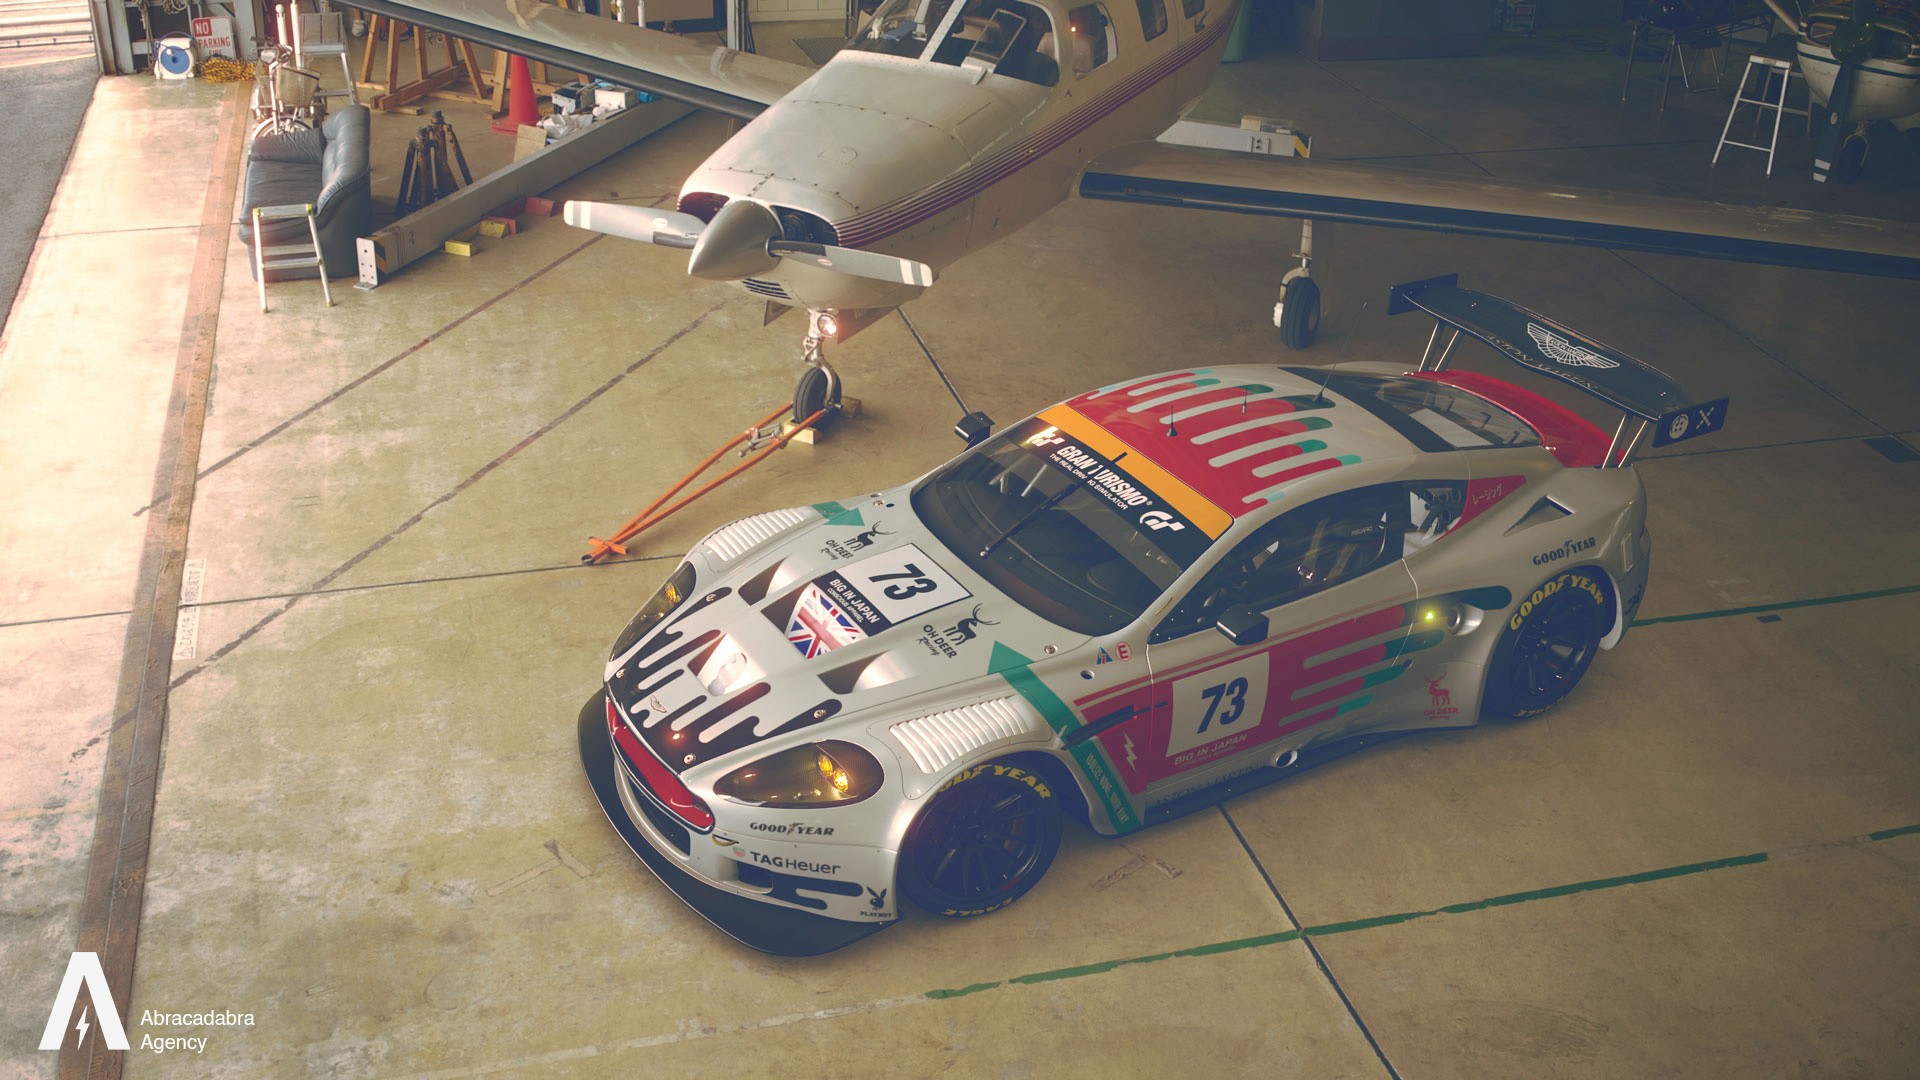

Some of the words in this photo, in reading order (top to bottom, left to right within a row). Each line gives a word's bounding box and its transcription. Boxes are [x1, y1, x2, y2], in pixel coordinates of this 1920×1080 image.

[195, 22, 209, 35] NO
[198, 37, 231, 49] PARKING
[1056, 445, 1098, 475] GRAN
[1049, 453, 1059, 463] THE
[1058, 460, 1074, 473] REAL
[1093, 484, 1129, 511] SIMULATOR
[868, 563, 938, 601] 73
[829, 578, 847, 593] BIG
[842, 587, 856, 600] IN
[850, 595, 881, 624] JAPAN
[922, 624, 940, 639] OH
[933, 637, 958, 659] DEER
[1117, 644, 1130, 660] E
[1197, 676, 1249, 735] 73
[1174, 752, 1194, 766] BIG
[1197, 746, 1210, 756] IN
[1211, 733, 1249, 753] JAPAN
[749, 822, 835, 836] GOODYEAR
